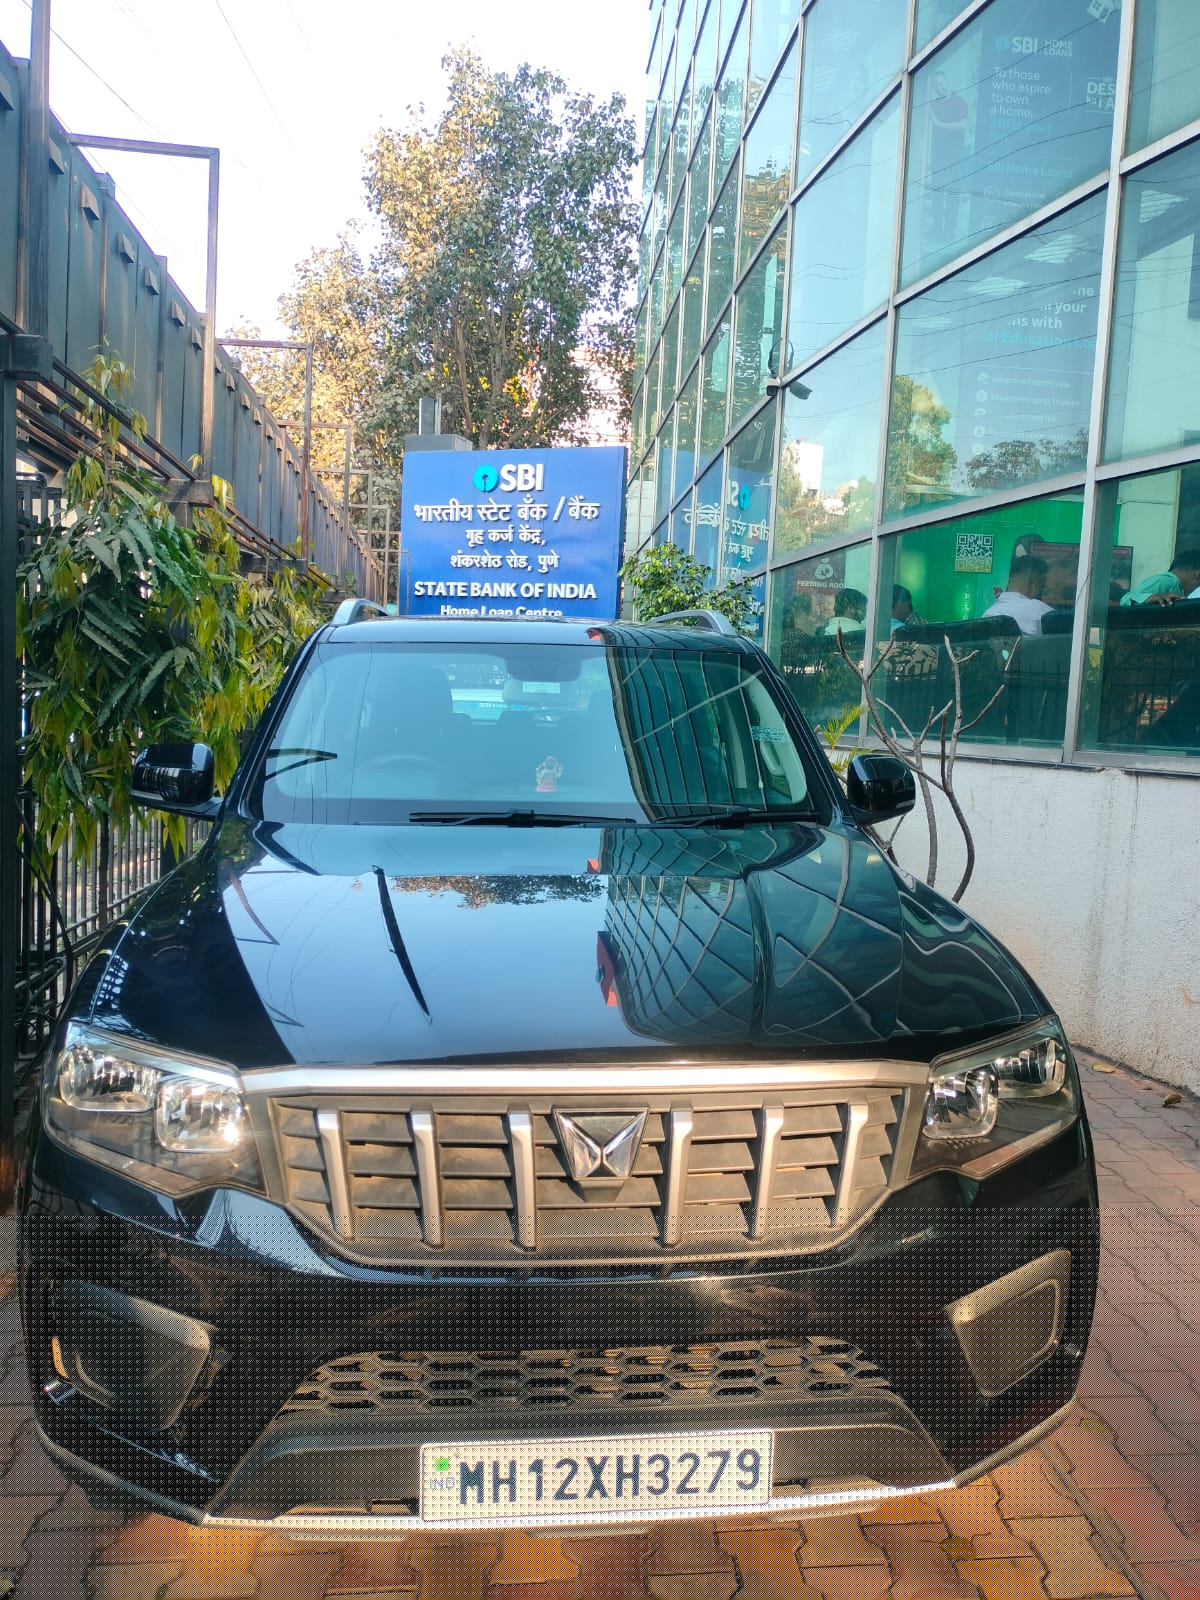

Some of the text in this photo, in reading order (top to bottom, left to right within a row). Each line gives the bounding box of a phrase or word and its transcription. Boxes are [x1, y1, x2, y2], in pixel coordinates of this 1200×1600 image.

[1011, 36, 1038, 54] SBI
[1045, 39, 1073, 49] HOME
[1044, 48, 1073, 57] LOANS
[993, 66, 1041, 81] To those
[992, 80, 1052, 95] who aspire
[991, 93, 1029, 105] to own
[1055, 302, 1087, 314] your
[1032, 316, 1063, 329] with
[500, 463, 544, 492] SBI
[413, 497, 474, 522] भारतीय
[477, 497, 512, 521] स्टेट
[552, 495, 566, 521] /
[567, 495, 601, 521] बैंक
[465, 524, 546, 548] गृह कर्ज केंद्र,
[450, 549, 560, 573] शंकरशेठ रोड, पुणे
[414, 581, 598, 599] STATE BANK OF INDIA
[796, 580, 827, 588] FEEDING
[440, 604, 563, 617] Home Loan Centre
[429, 1447, 761, 1506] IND MH12XH3279
